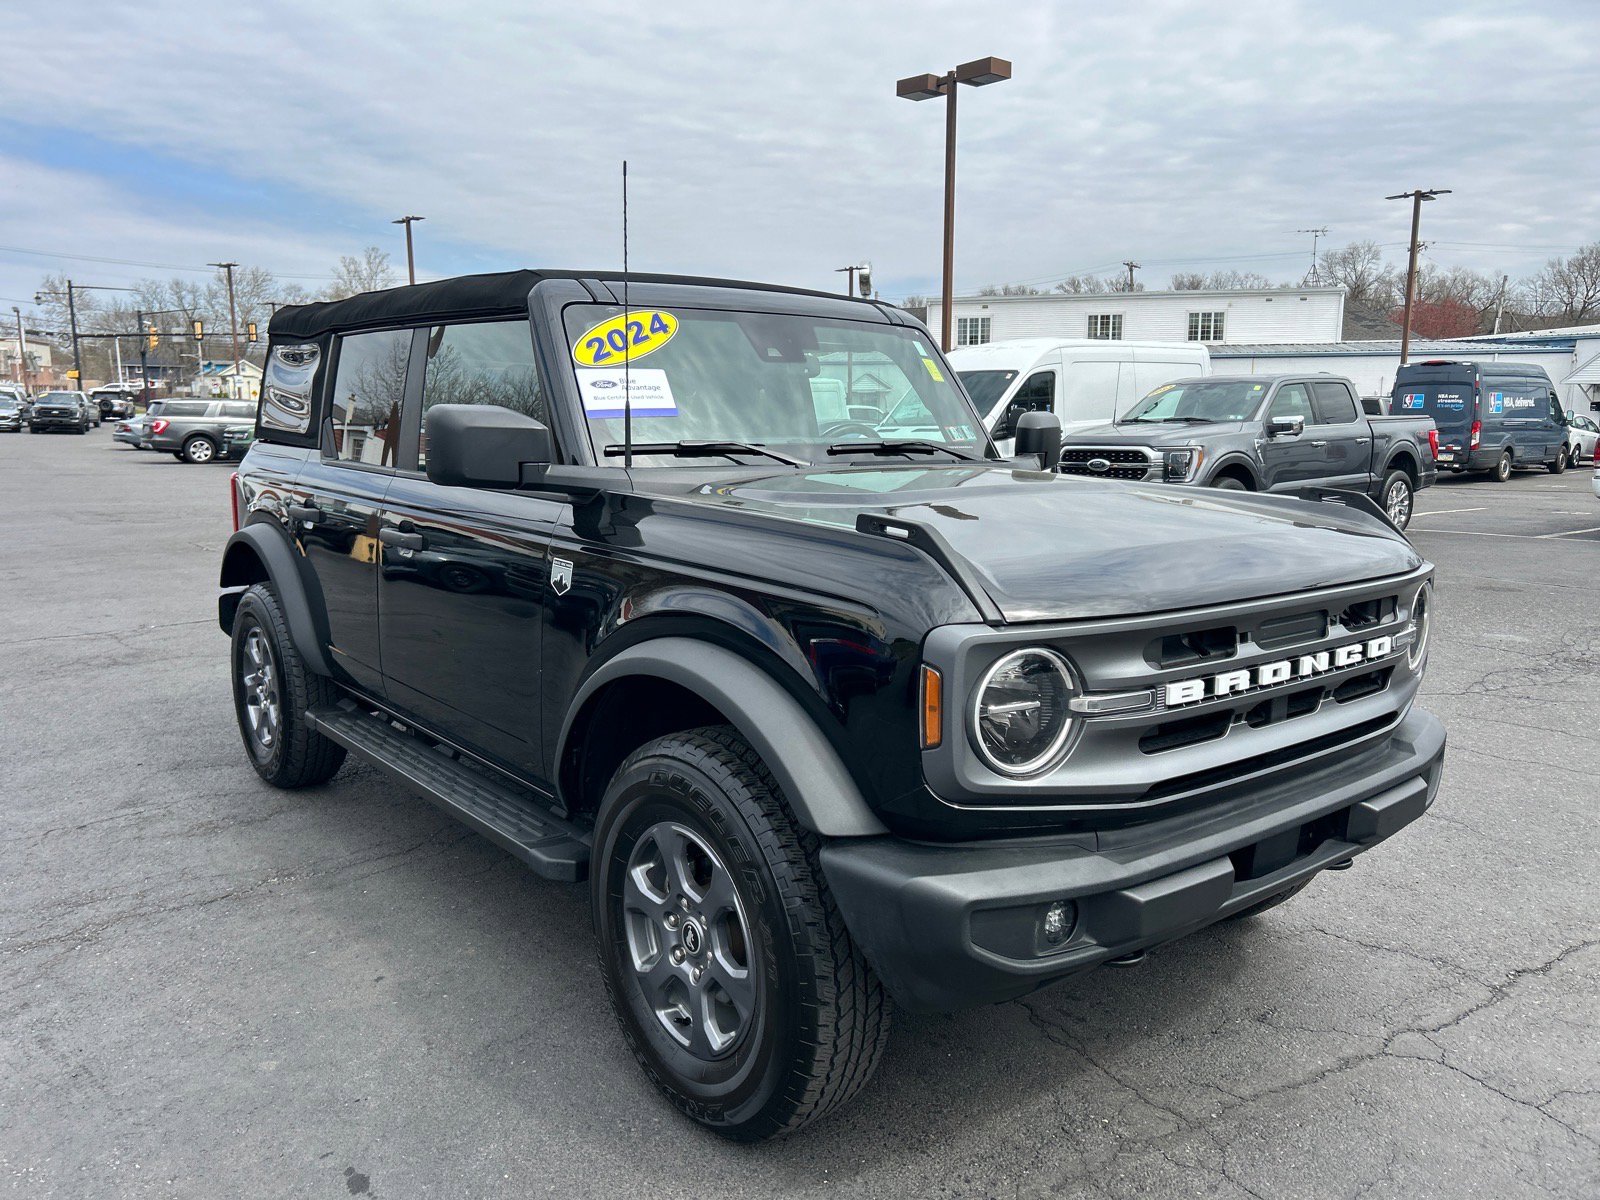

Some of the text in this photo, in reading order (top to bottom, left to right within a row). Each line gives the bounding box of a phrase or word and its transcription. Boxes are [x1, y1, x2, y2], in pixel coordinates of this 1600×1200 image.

[586, 313, 670, 363] 2024
[1166, 636, 1391, 706] BRONCO
[649, 769, 767, 904] DUELER
